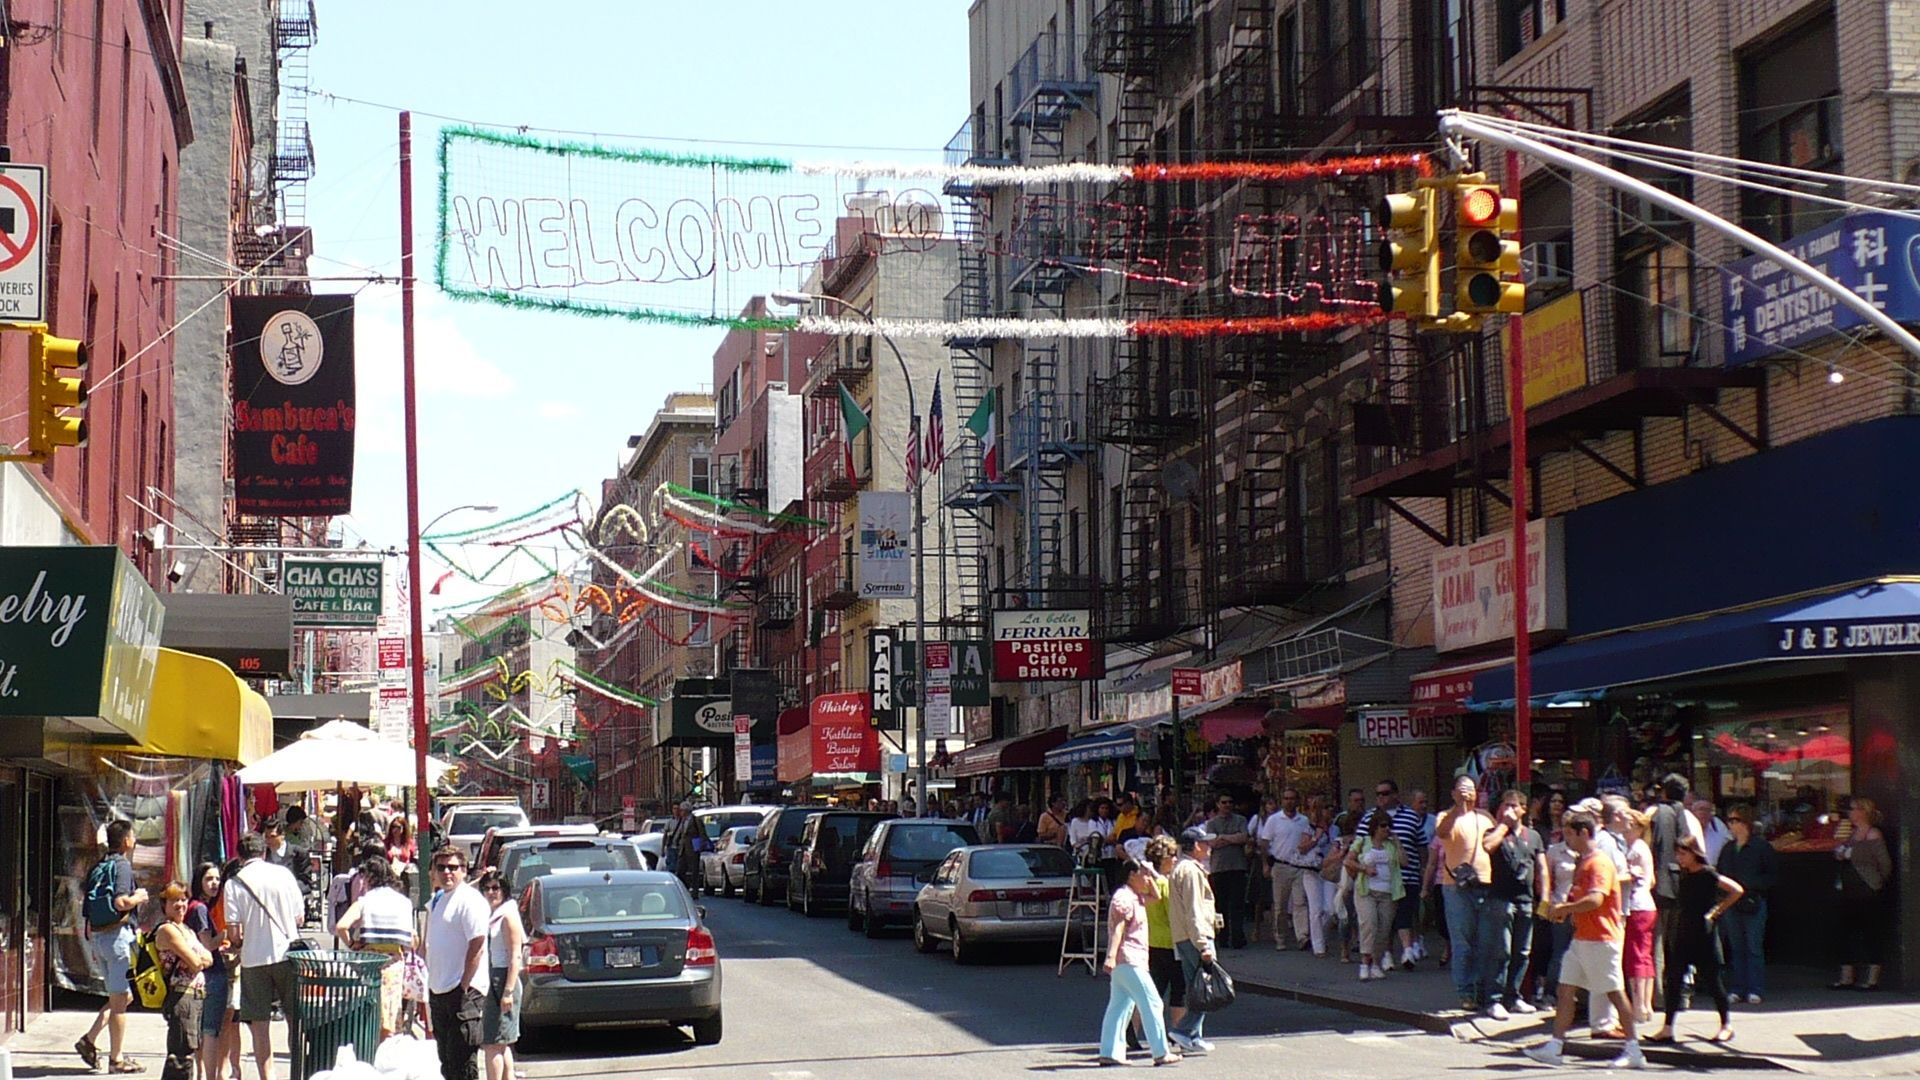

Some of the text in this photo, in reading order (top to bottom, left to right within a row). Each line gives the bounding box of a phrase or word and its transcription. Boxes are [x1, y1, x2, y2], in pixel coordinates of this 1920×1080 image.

[453, 194, 824, 289] WELCOME
[842, 188, 945, 255] TO
[1229, 212, 1391, 305] ITAL
[235, 398, 355, 432] Sambuca's
[271, 433, 318, 465] Cafe
[287, 567, 378, 586] CHA CHA'S
[287, 586, 378, 599] BACKYARD GARDEN
[863, 583, 905, 595] Sorrento
[1440, 569, 1475, 610] ARAMI
[291, 598, 329, 612] CAFE
[343, 599, 374, 612] BAR
[1018, 612, 1077, 624] La bella
[1780, 628, 1795, 650] J
[1801, 627, 1817, 649] &
[1823, 626, 1839, 648] E
[1011, 640, 1084, 654] Pastries
[240, 657, 261, 670] 105
[1028, 651, 1067, 665] Café
[873, 634, 892, 711] PARK
[1018, 665, 1078, 678] Bakery
[818, 700, 864, 716] Shirley's
[821, 726, 863, 740] Kathleen
[1366, 715, 1457, 739] PERFUMES
[825, 741, 861, 757] Beauty
[828, 756, 857, 770] Salon
